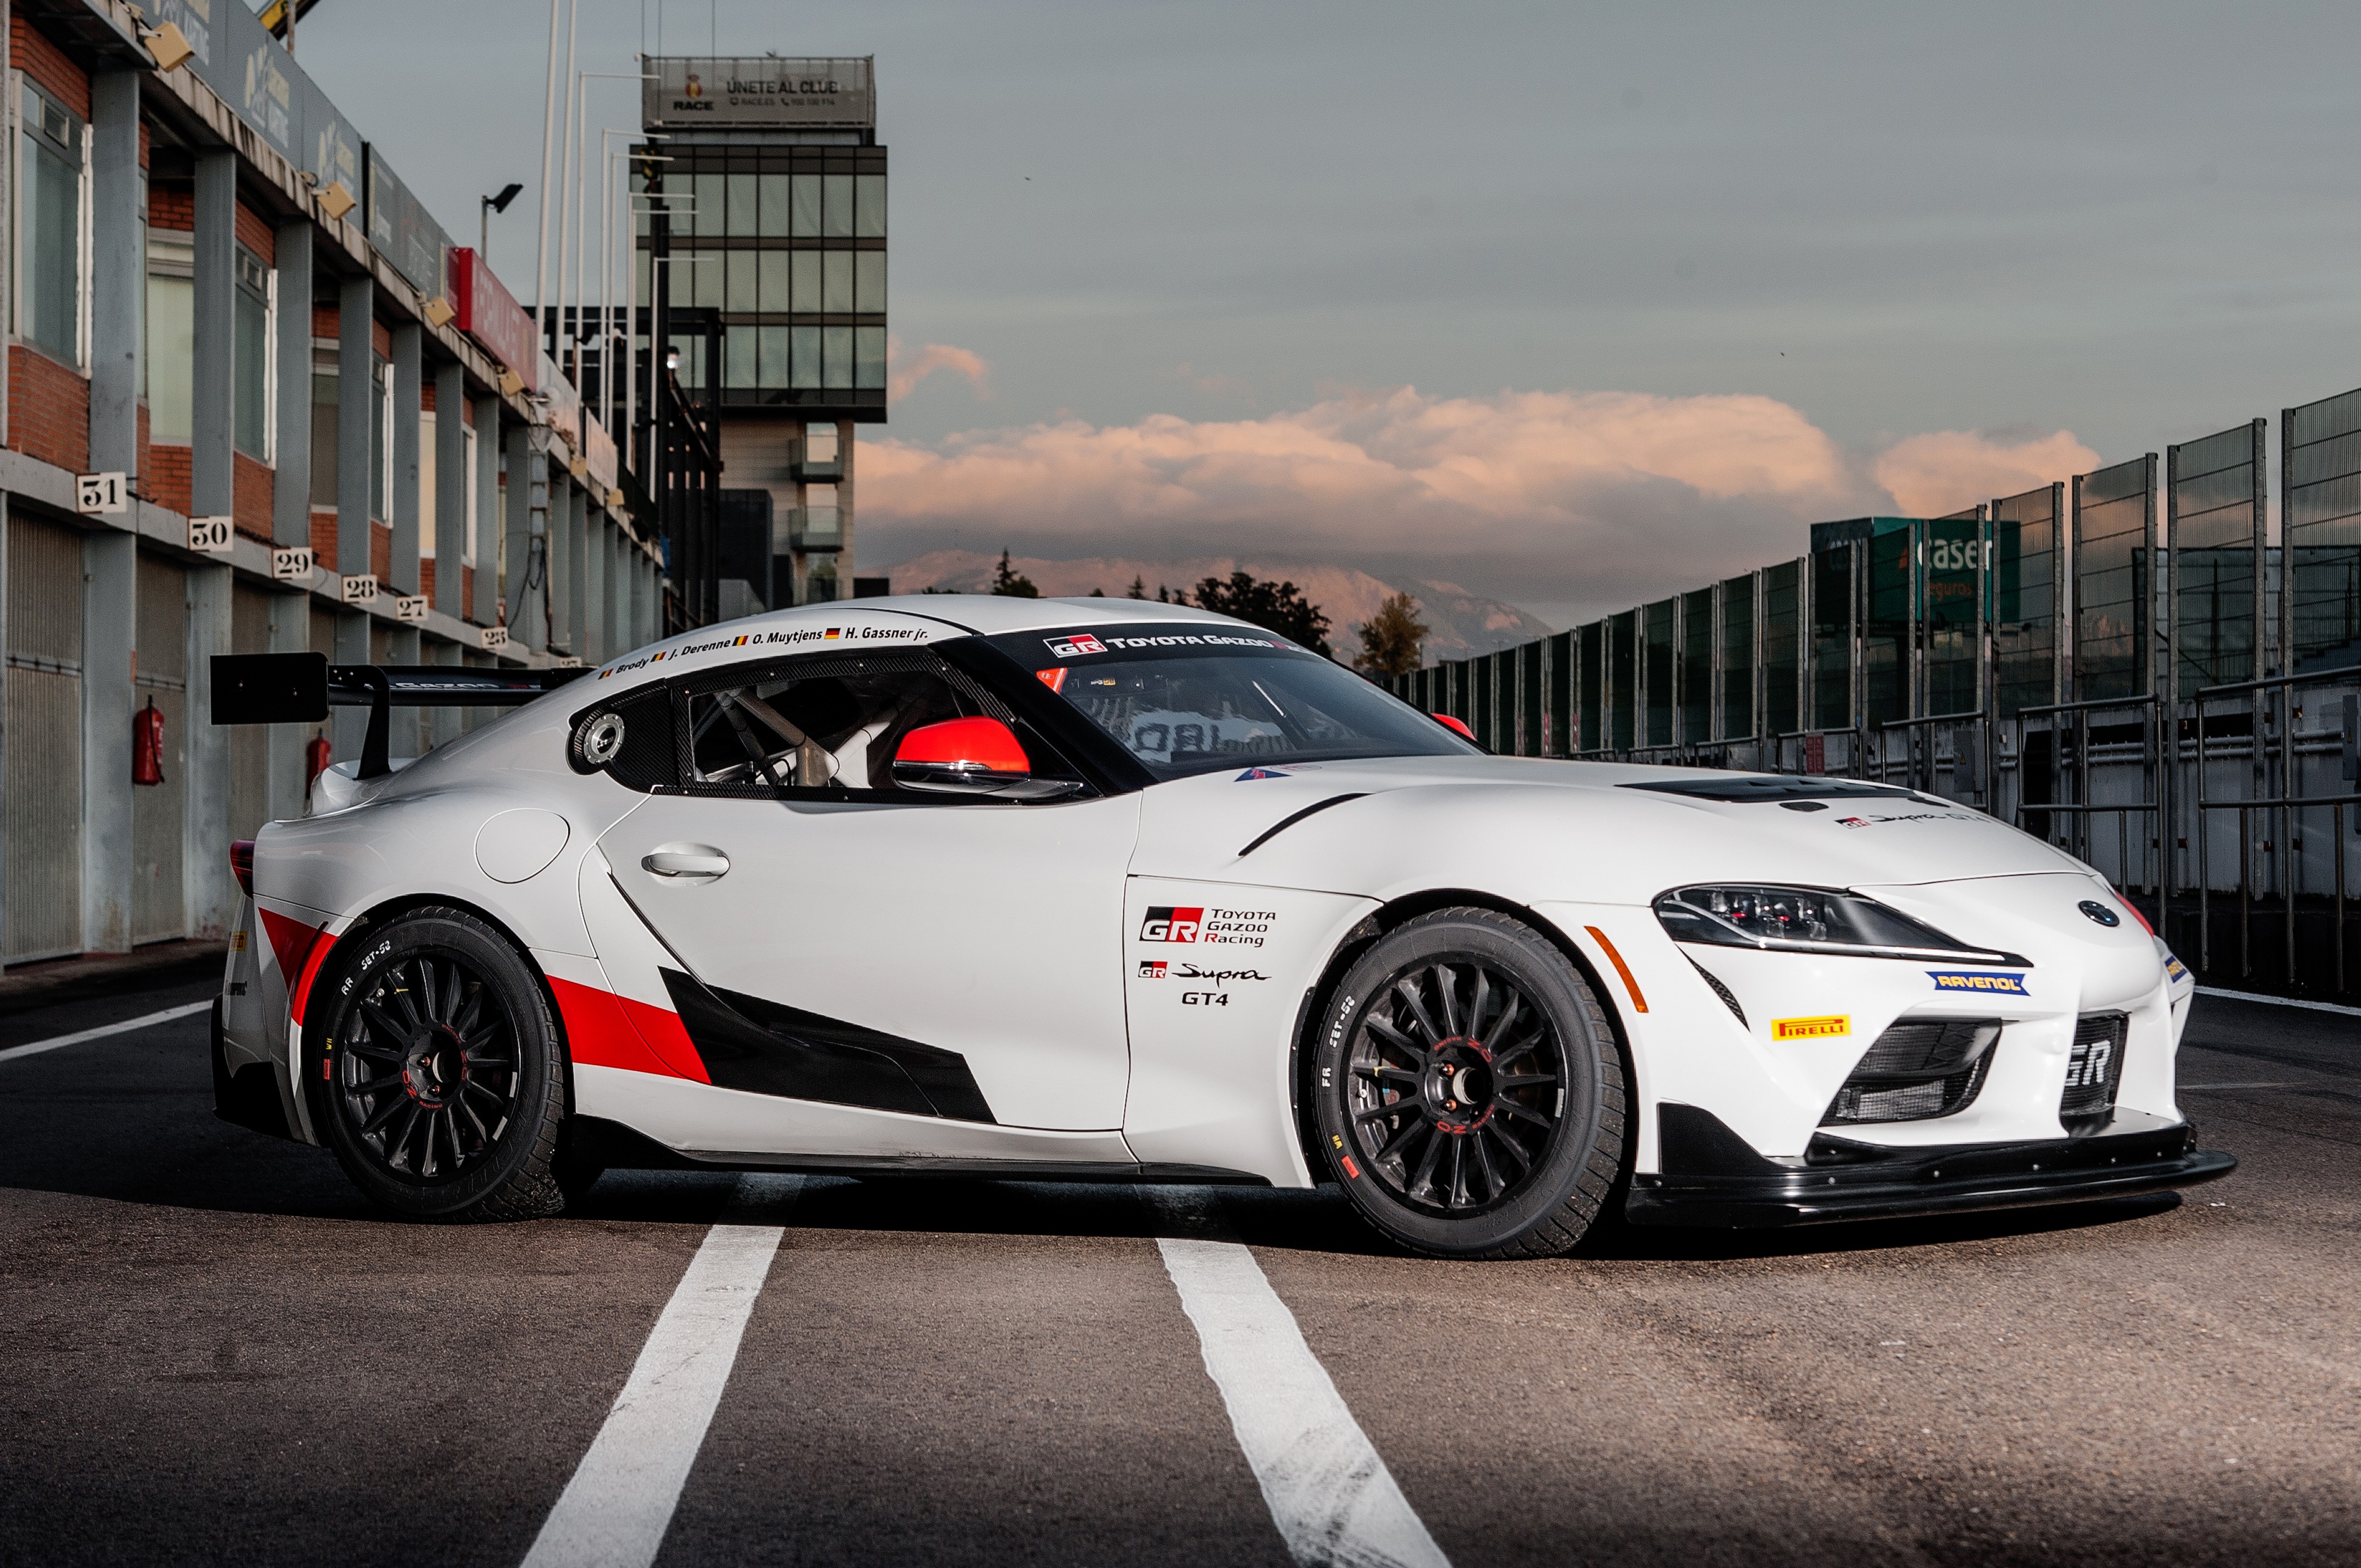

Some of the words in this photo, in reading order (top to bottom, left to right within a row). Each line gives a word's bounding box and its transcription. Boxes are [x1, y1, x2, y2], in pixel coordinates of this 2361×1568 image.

[778, 81, 797, 94] AL
[673, 101, 713, 110] RACE
[277, 553, 310, 574] 29
[346, 580, 375, 598] 28
[1929, 582, 1973, 602] eguros
[398, 599, 426, 617] 27
[616, 658, 649, 674] Brody
[668, 649, 678, 661] J.
[681, 640, 731, 656] Derenne
[752, 634, 764, 644] O.
[766, 629, 823, 645] Muytjens
[845, 627, 858, 639] H.
[862, 627, 913, 639] Gassner
[913, 629, 928, 641] jr.
[1053, 641, 1105, 655] GR
[1106, 635, 1204, 649] TOYOTA
[1203, 634, 1274, 648] GAZOO
[1868, 815, 1945, 824] Supra
[1211, 908, 1276, 920] TOYOTA
[1141, 920, 1199, 942] GR
[1207, 921, 1268, 933] GAZOO
[1204, 933, 1264, 948] Racing
[1138, 966, 1167, 978] GR
[1171, 963, 1272, 989] Supra
[1936, 976, 2021, 991] RAVENOL
[341, 976, 353, 995] RR
[1182, 992, 1228, 1006] GT4
[1779, 1019, 1844, 1037] PIRELLI
[2064, 1039, 2111, 1086] GR
[1322, 1067, 1331, 1087] FR
